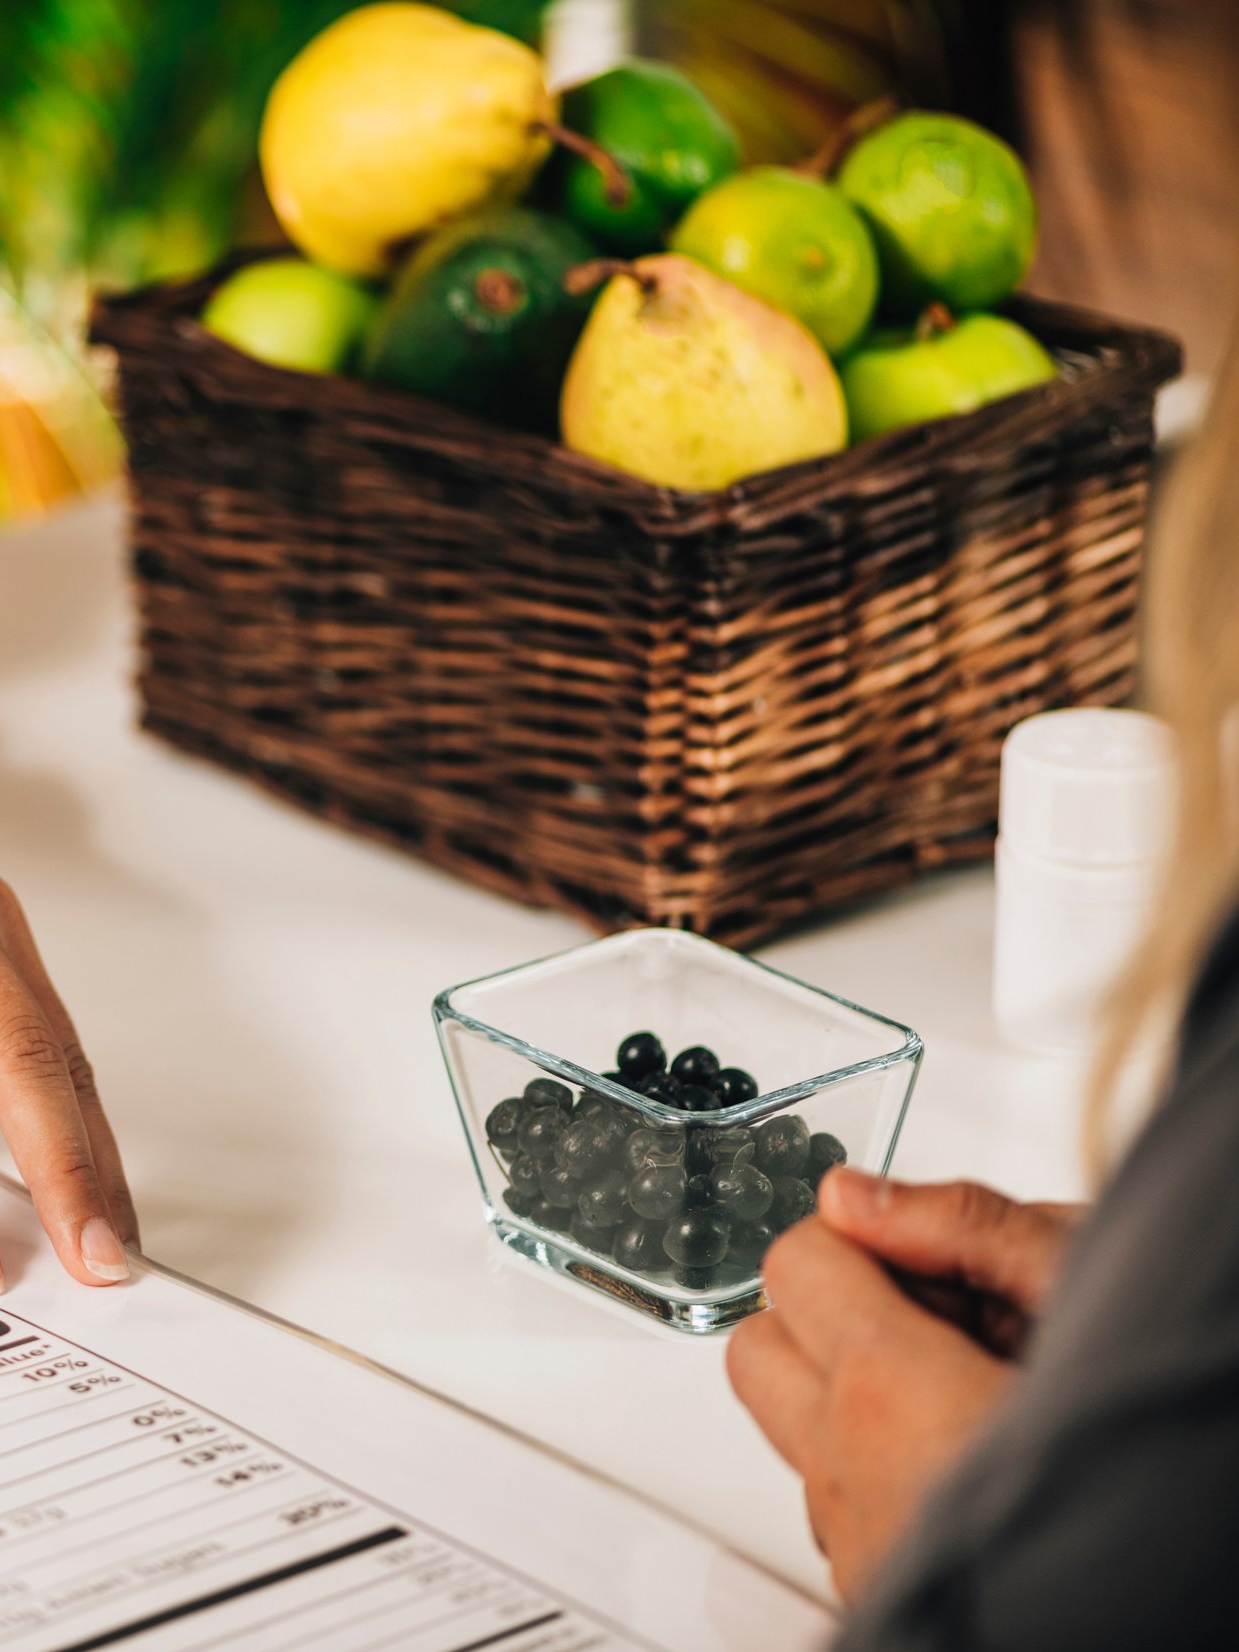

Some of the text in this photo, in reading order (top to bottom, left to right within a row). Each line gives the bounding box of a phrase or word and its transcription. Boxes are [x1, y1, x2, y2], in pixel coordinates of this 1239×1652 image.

[21, 1358, 88, 1383] 10%
[68, 1374, 121, 1394] 5%
[132, 1407, 186, 1427] 0%
